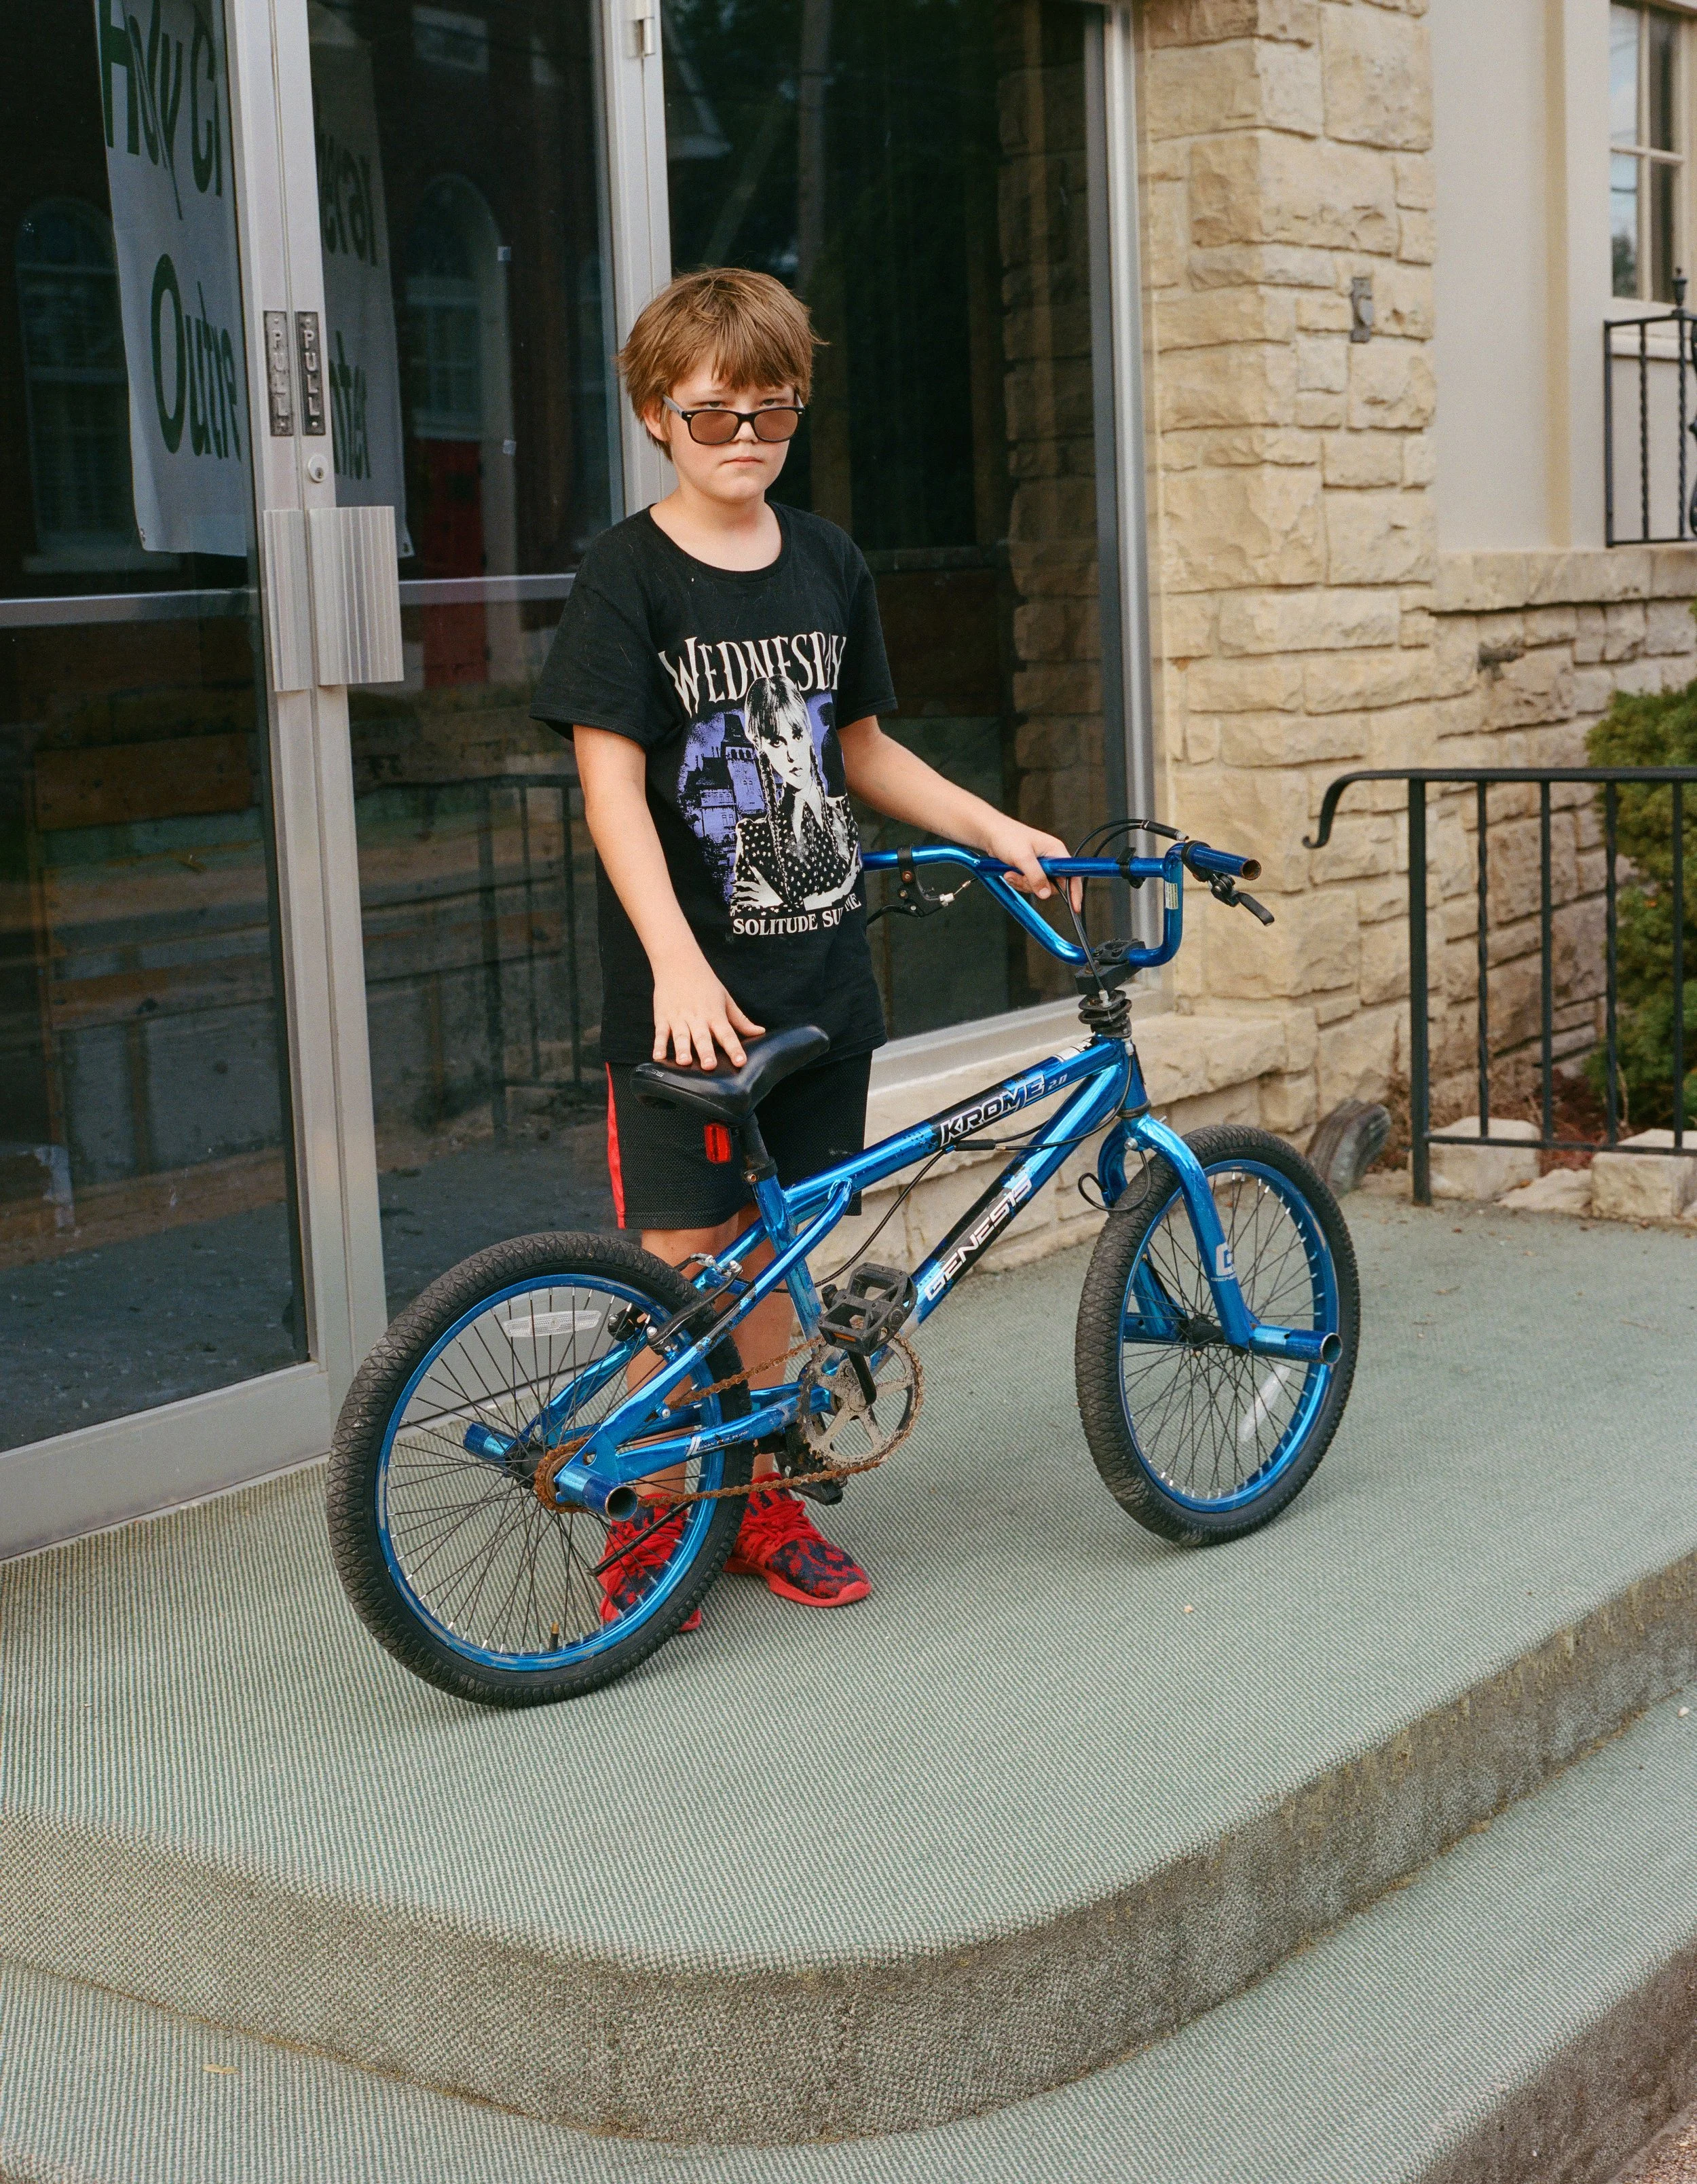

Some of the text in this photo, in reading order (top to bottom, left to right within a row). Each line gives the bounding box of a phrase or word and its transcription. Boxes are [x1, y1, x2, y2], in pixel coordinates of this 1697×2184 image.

[273, 329, 288, 416] PULL
[304, 329, 320, 416] PULL
[732, 913, 818, 936] SOLITUDE
[939, 1073, 1068, 1147] KROME 2.0
[924, 1173, 1032, 1301] GENESIS
